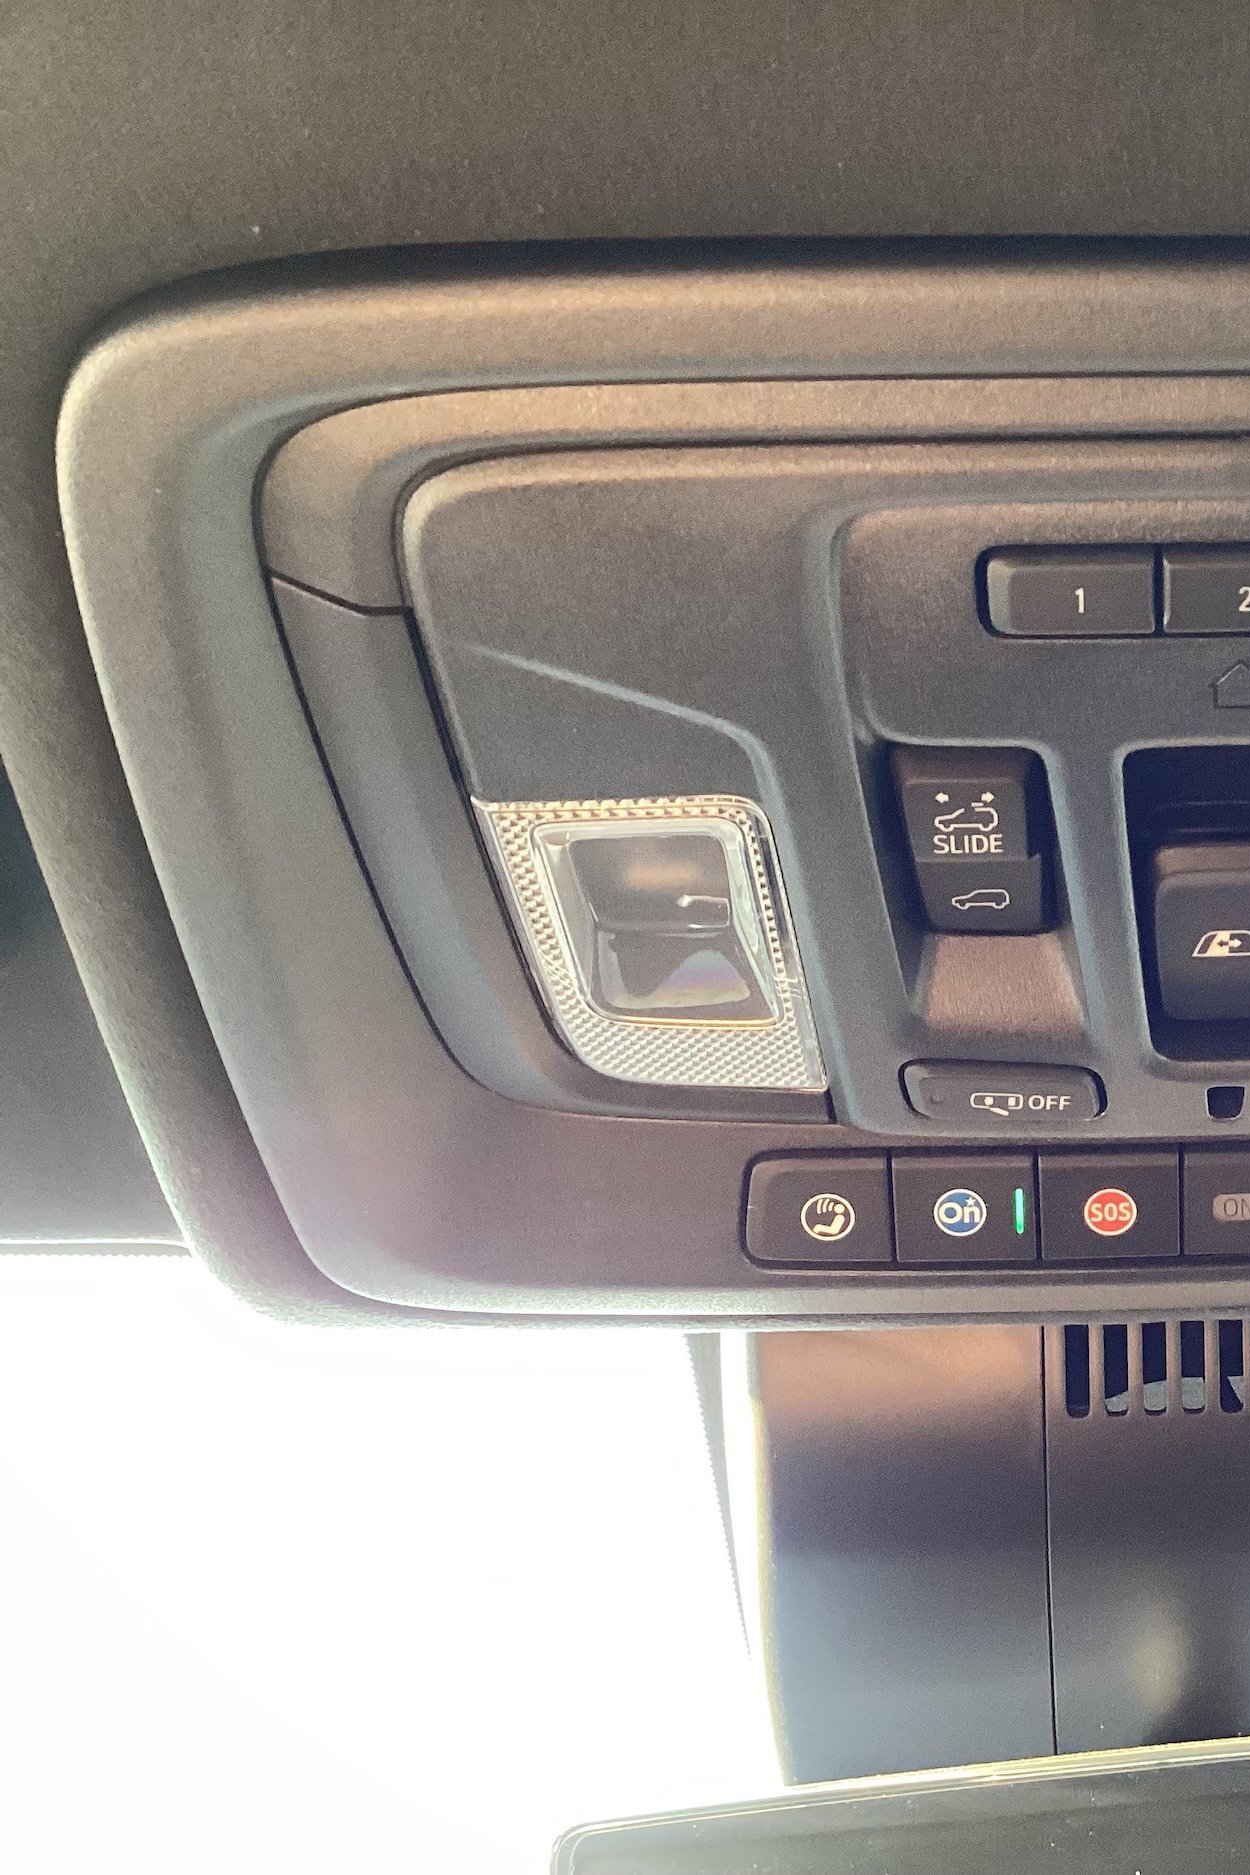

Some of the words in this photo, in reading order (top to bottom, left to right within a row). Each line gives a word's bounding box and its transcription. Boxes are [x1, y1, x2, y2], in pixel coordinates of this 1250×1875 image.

[1074, 587, 1086, 613] 1
[933, 833, 1004, 855] SLIDE
[1027, 1094, 1072, 1112] OFF
[938, 1202, 981, 1224] On
[1090, 1202, 1132, 1222] SOS
